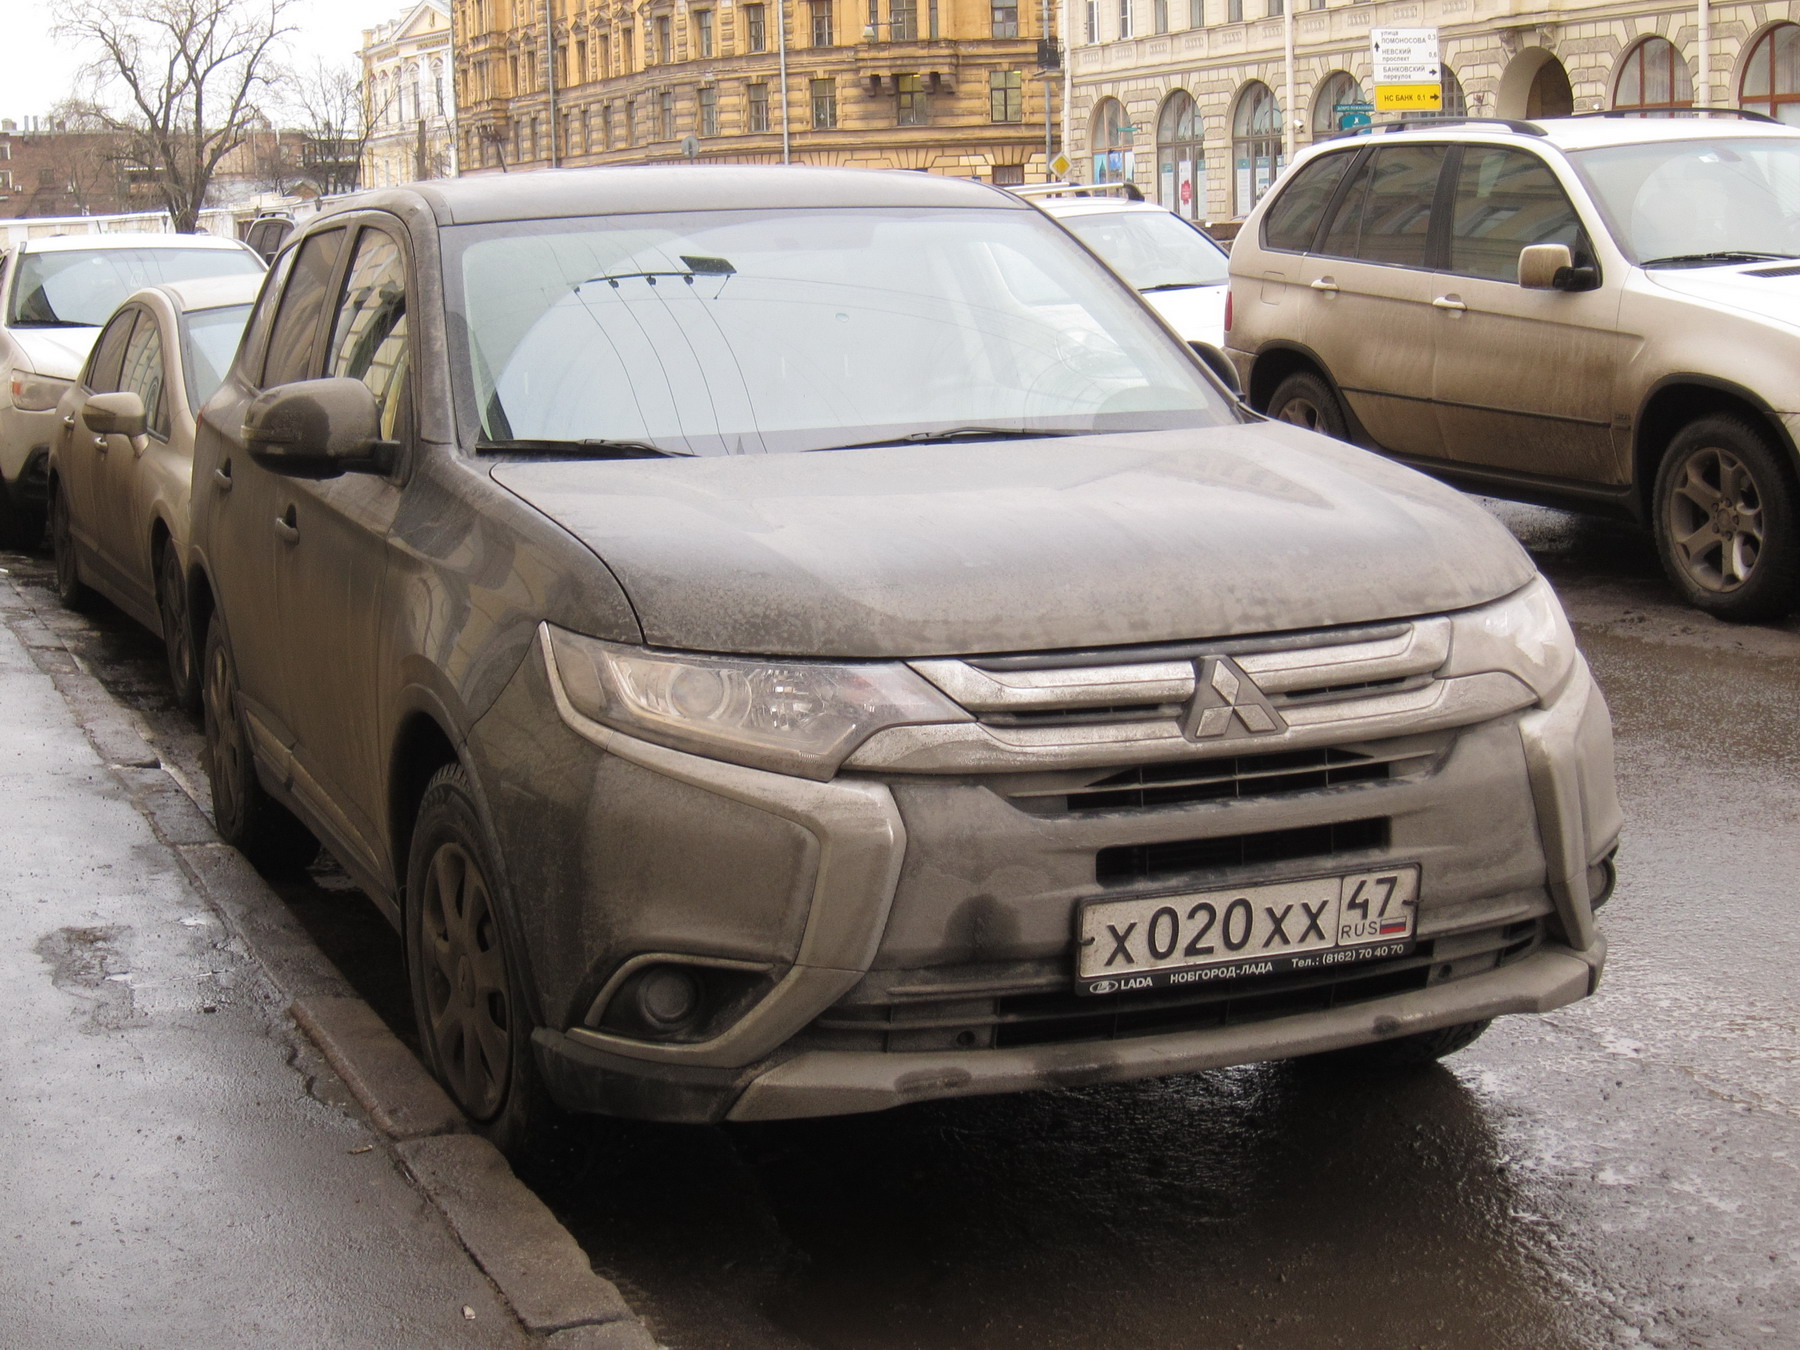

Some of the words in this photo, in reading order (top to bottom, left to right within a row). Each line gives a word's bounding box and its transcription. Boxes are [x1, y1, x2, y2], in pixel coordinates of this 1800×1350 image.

[1383, 65, 1425, 73] БАНКОВСКИЙ
[1395, 94, 1413, 102] БАНК
[1347, 875, 1398, 920] 47
[1341, 921, 1378, 939] RUS
[1322, 950, 1356, 965] (8162)
[1359, 947, 1372, 959] 70
[1374, 946, 1388, 957] 40
[1390, 943, 1404, 955] 70
[1170, 962, 1273, 984] НОВГОРОД-ЛАДА
[1120, 976, 1153, 990] LADA
